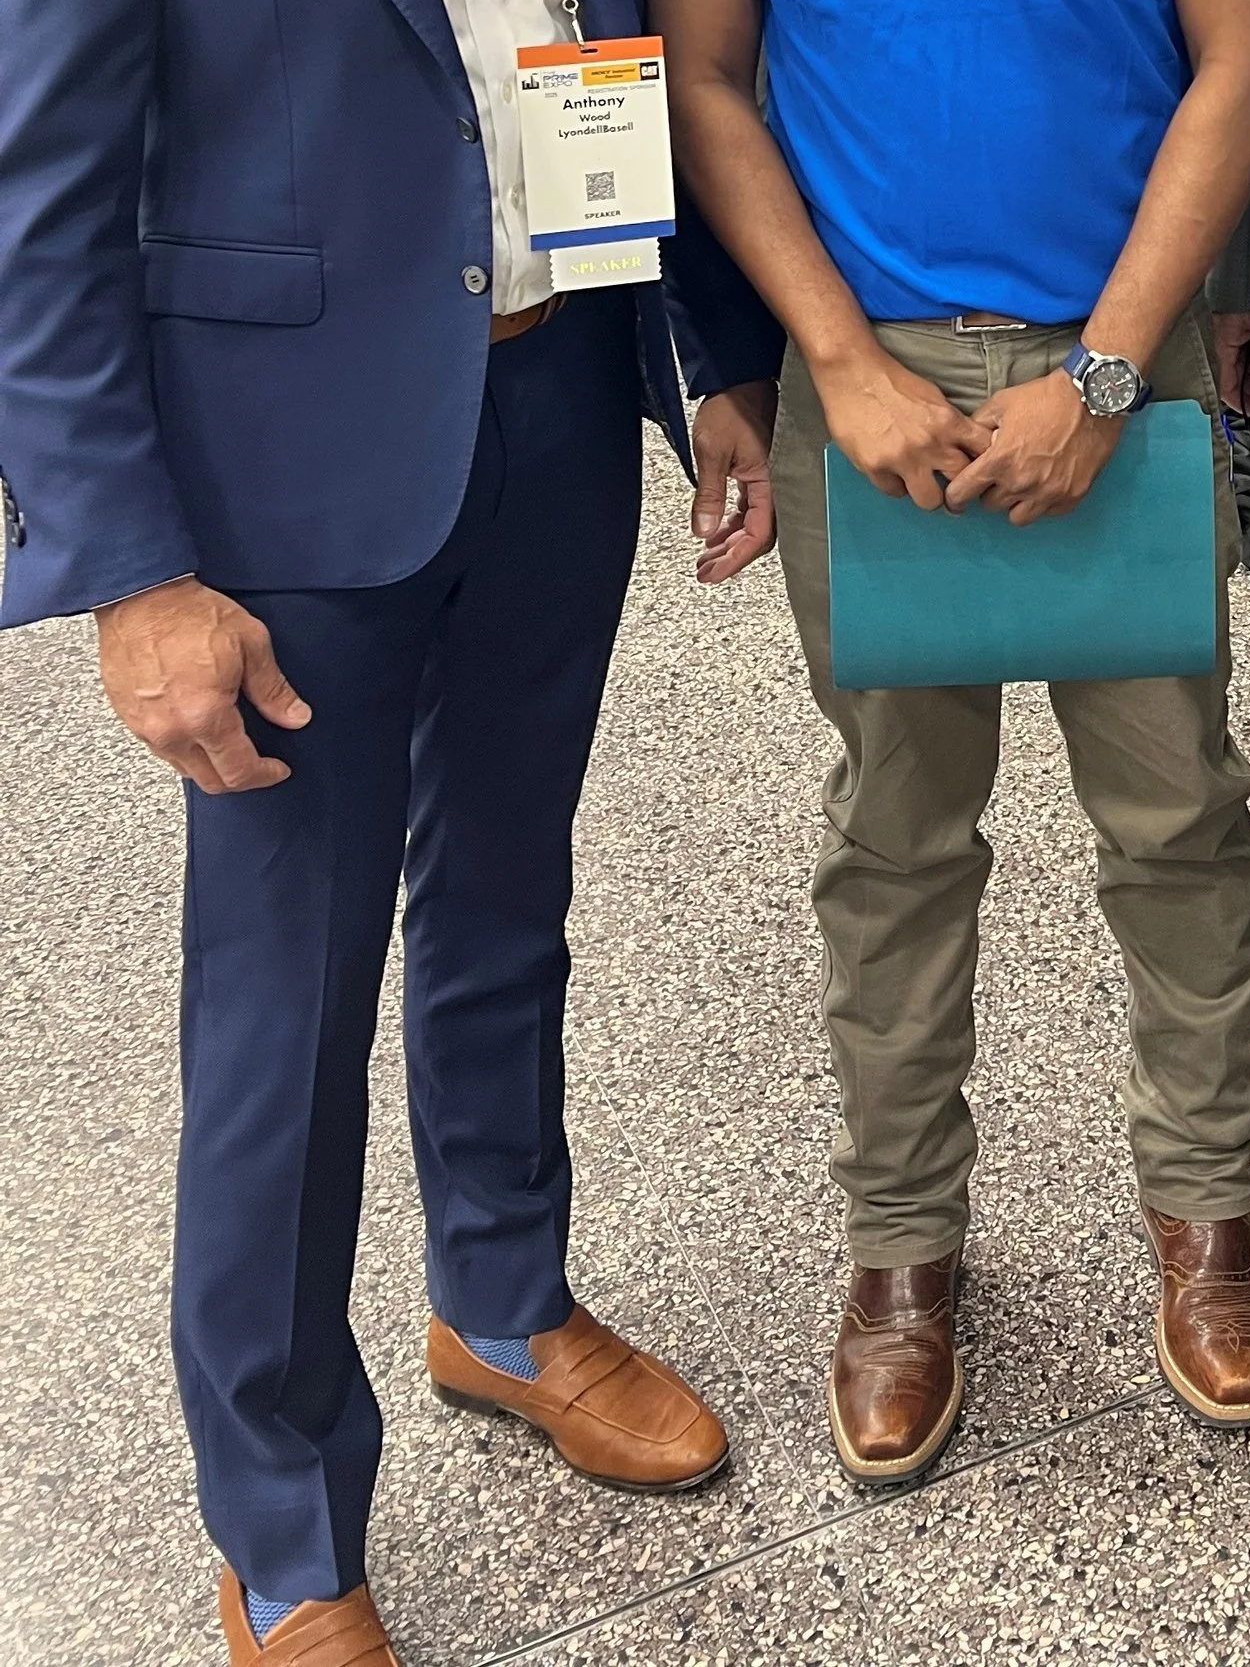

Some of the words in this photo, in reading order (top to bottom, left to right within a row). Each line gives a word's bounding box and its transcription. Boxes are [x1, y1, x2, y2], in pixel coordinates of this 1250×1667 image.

[543, 72, 578, 82] PRIME
[543, 80, 573, 89] EXPO
[562, 94, 625, 111] Anthony
[579, 111, 611, 123] Wood
[558, 121, 634, 139] LyondellBasell
[584, 210, 622, 220] SPEAKER
[569, 255, 642, 275] SPEAKER
